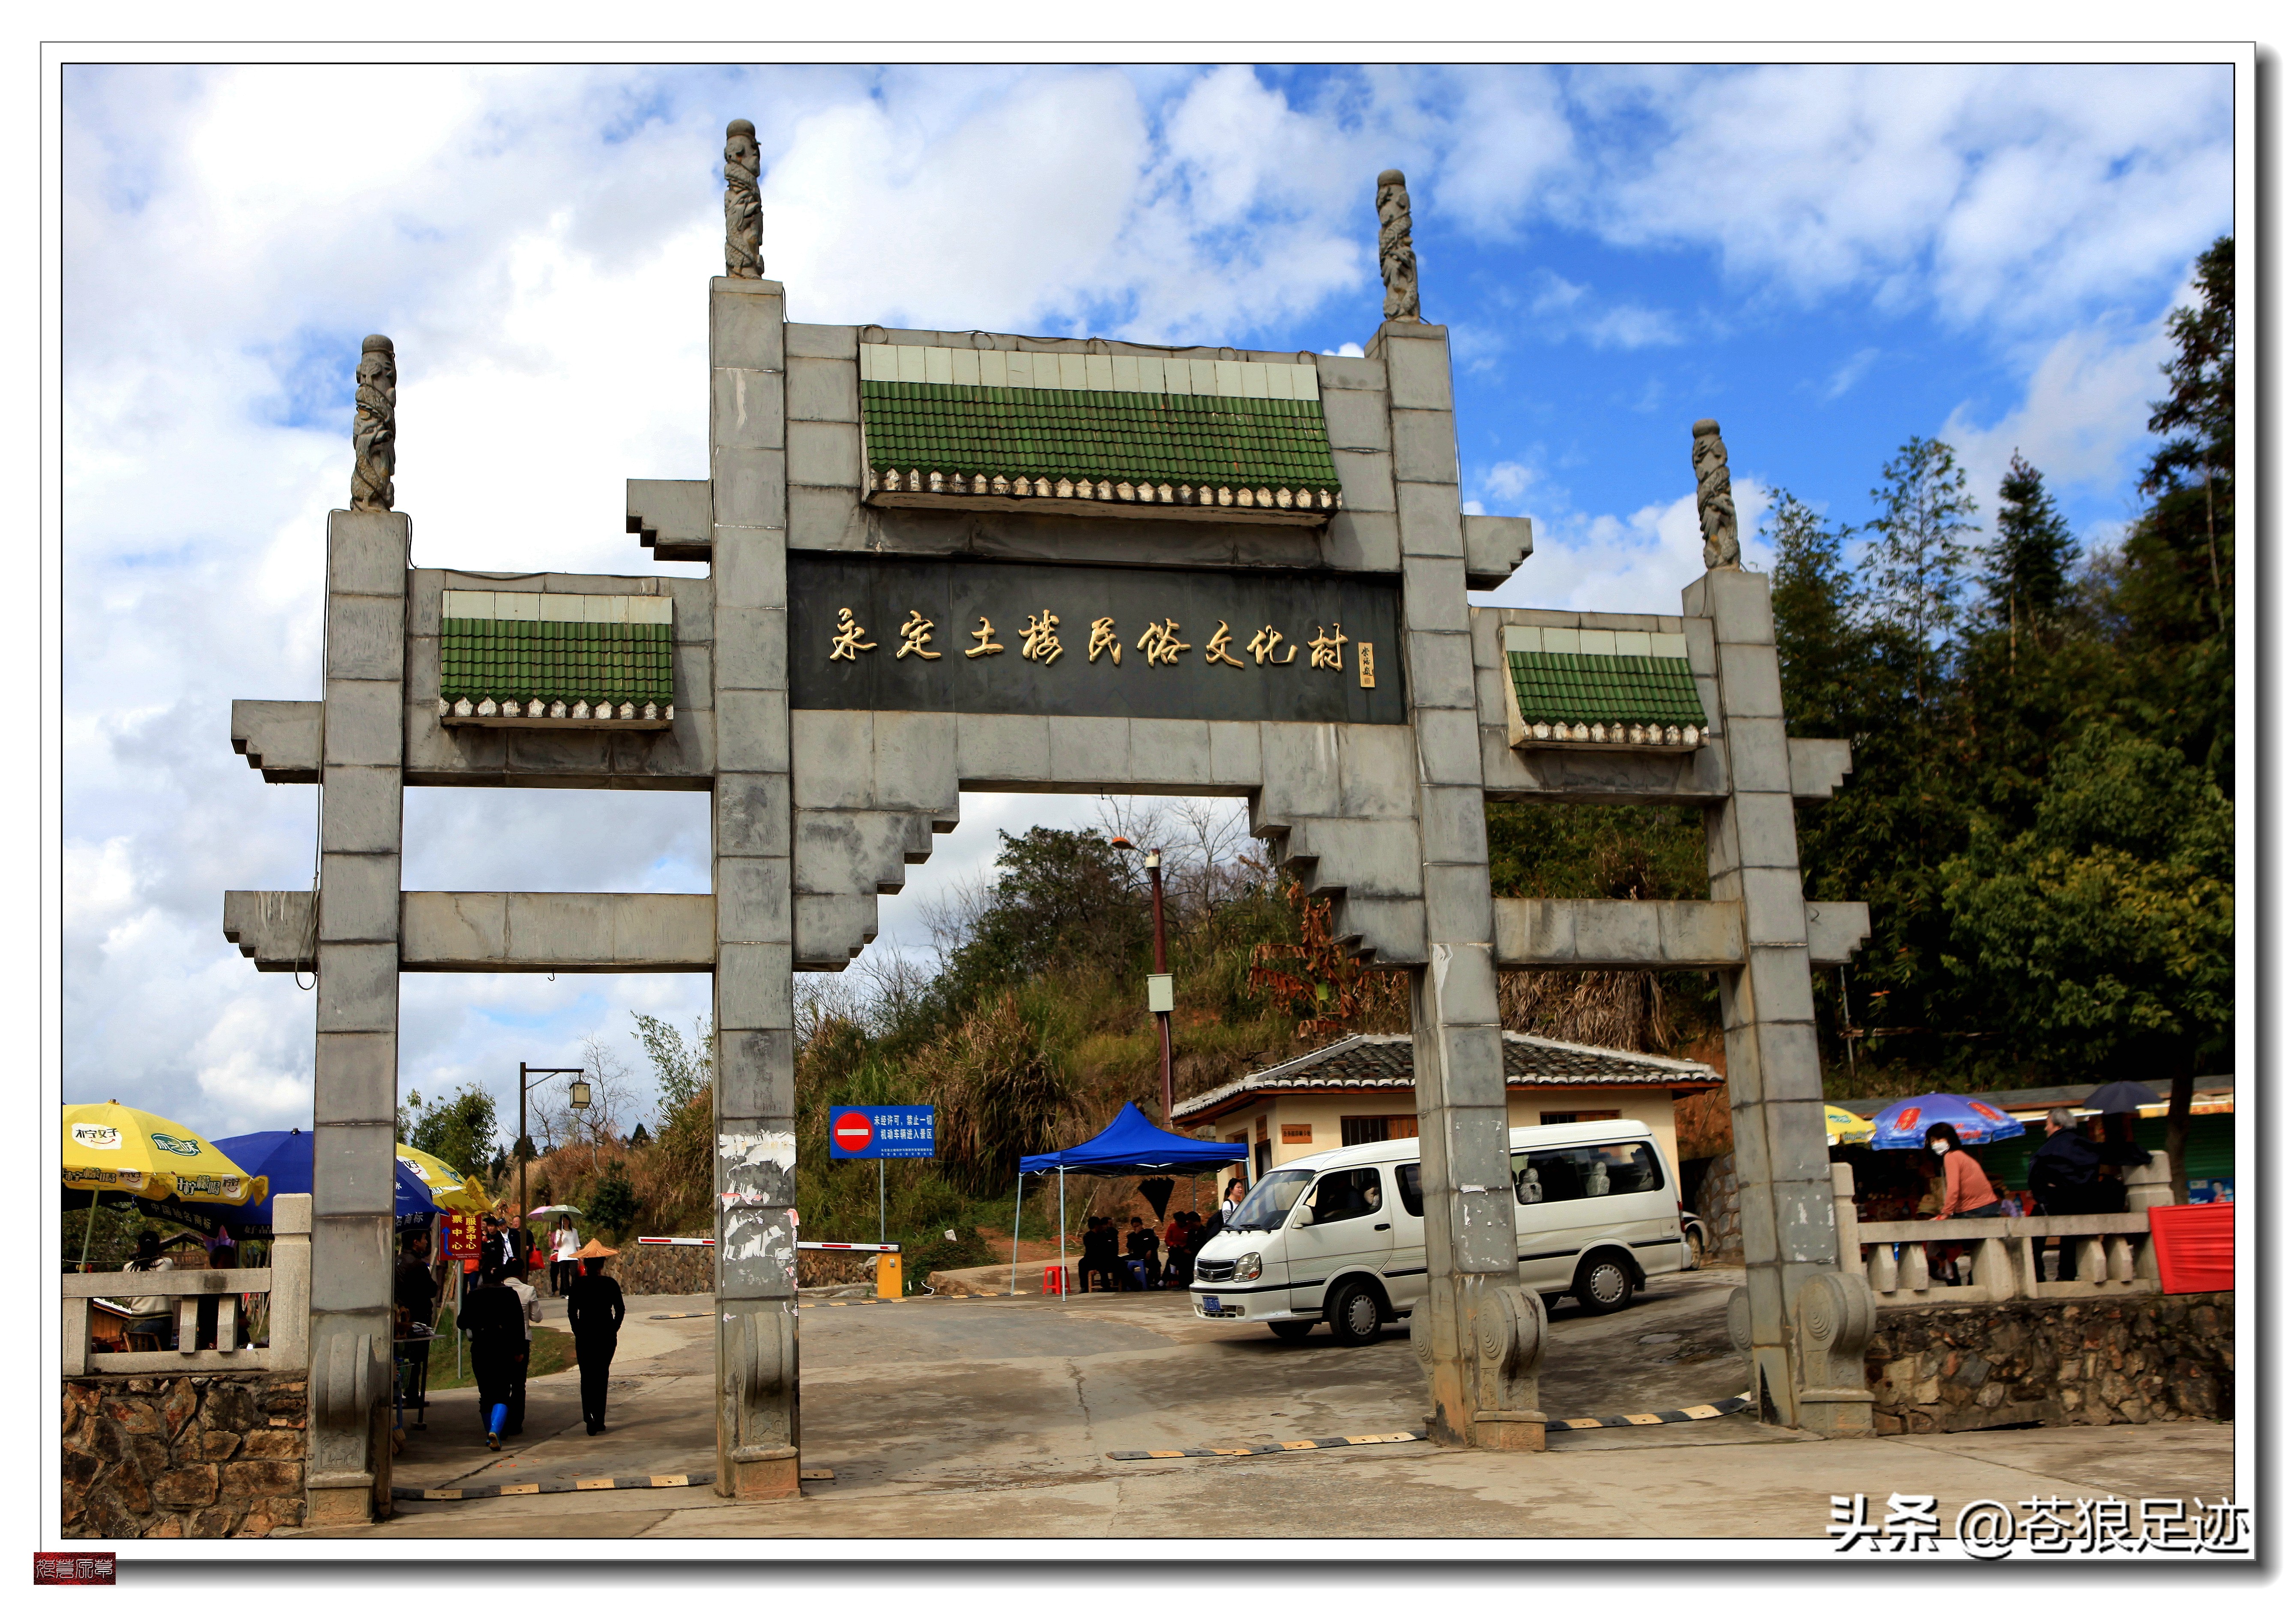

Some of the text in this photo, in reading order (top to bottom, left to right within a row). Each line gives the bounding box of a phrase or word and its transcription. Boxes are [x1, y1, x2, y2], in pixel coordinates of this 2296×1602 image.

[829, 607, 1348, 672] 永定土楼民俗文化村
[881, 1129, 933, 1139] 机动车辆进入景区
[151, 1202, 211, 1229] 中国驰名商标
[466, 1216, 476, 1249] 服务中心
